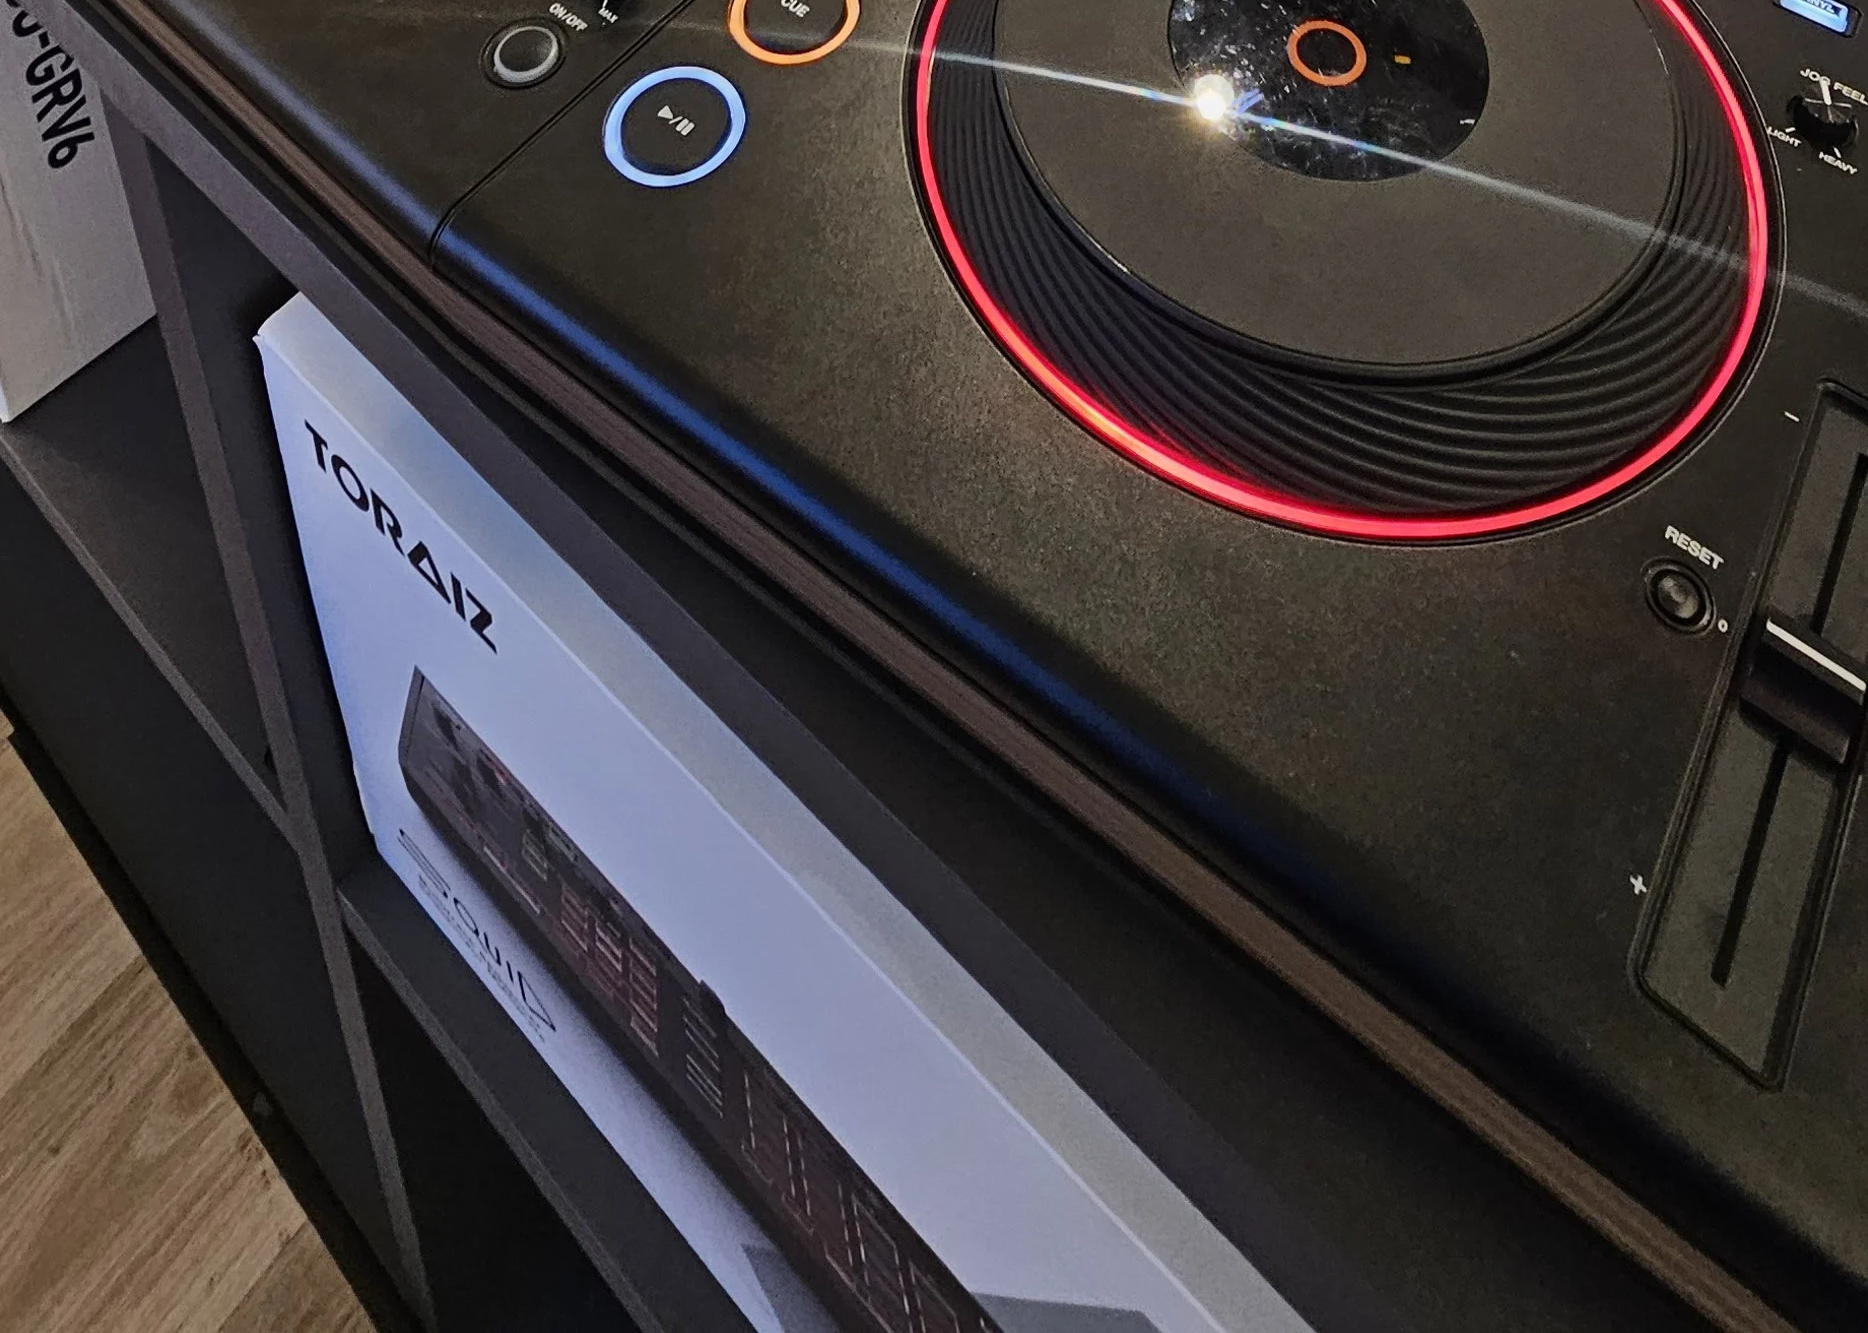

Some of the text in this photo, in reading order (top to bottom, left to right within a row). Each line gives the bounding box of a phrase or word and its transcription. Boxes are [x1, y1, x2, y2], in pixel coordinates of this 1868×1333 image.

[549, 2, 589, 32] ON/OFF
[598, 7, 619, 24] MAX
[1800, 68, 1868, 106] JOG FEEL
[1767, 125, 1802, 148] LIGHT
[1818, 150, 1858, 175] HEAVY
[304, 418, 498, 655] TORAIZ
[1664, 525, 1725, 571] RESET
[1717, 618, 1729, 633] 0
[397, 827, 557, 1032] SQUID
